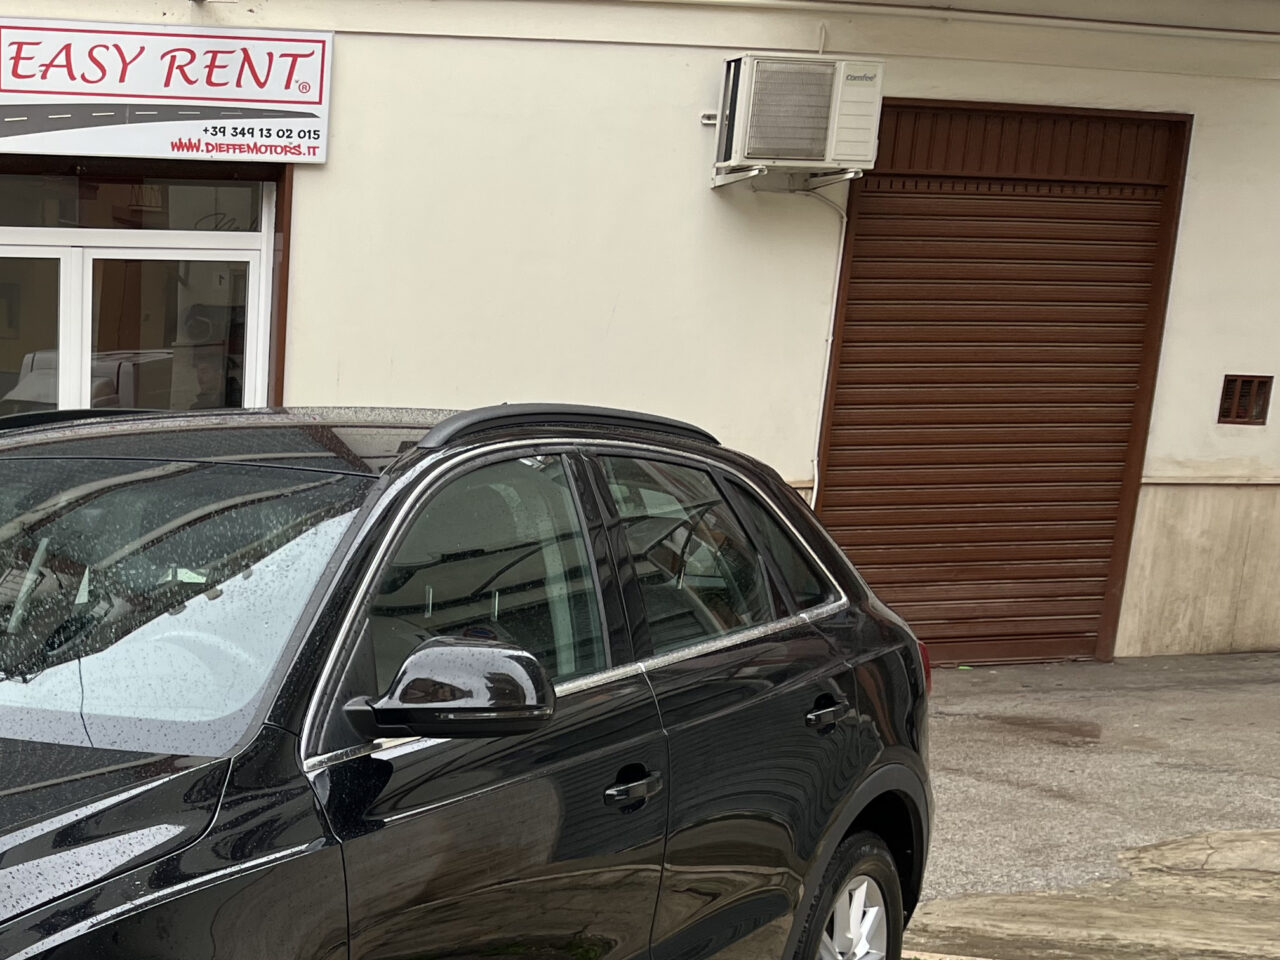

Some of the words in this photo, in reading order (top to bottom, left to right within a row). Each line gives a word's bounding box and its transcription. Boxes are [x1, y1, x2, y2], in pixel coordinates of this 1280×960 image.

[8, 41, 145, 84] EASY
[202, 126, 226, 137] +39
[230, 127, 255, 138] 349
[258, 128, 272, 138] 13
[276, 128, 293, 139] 02
[297, 129, 320, 140] 015
